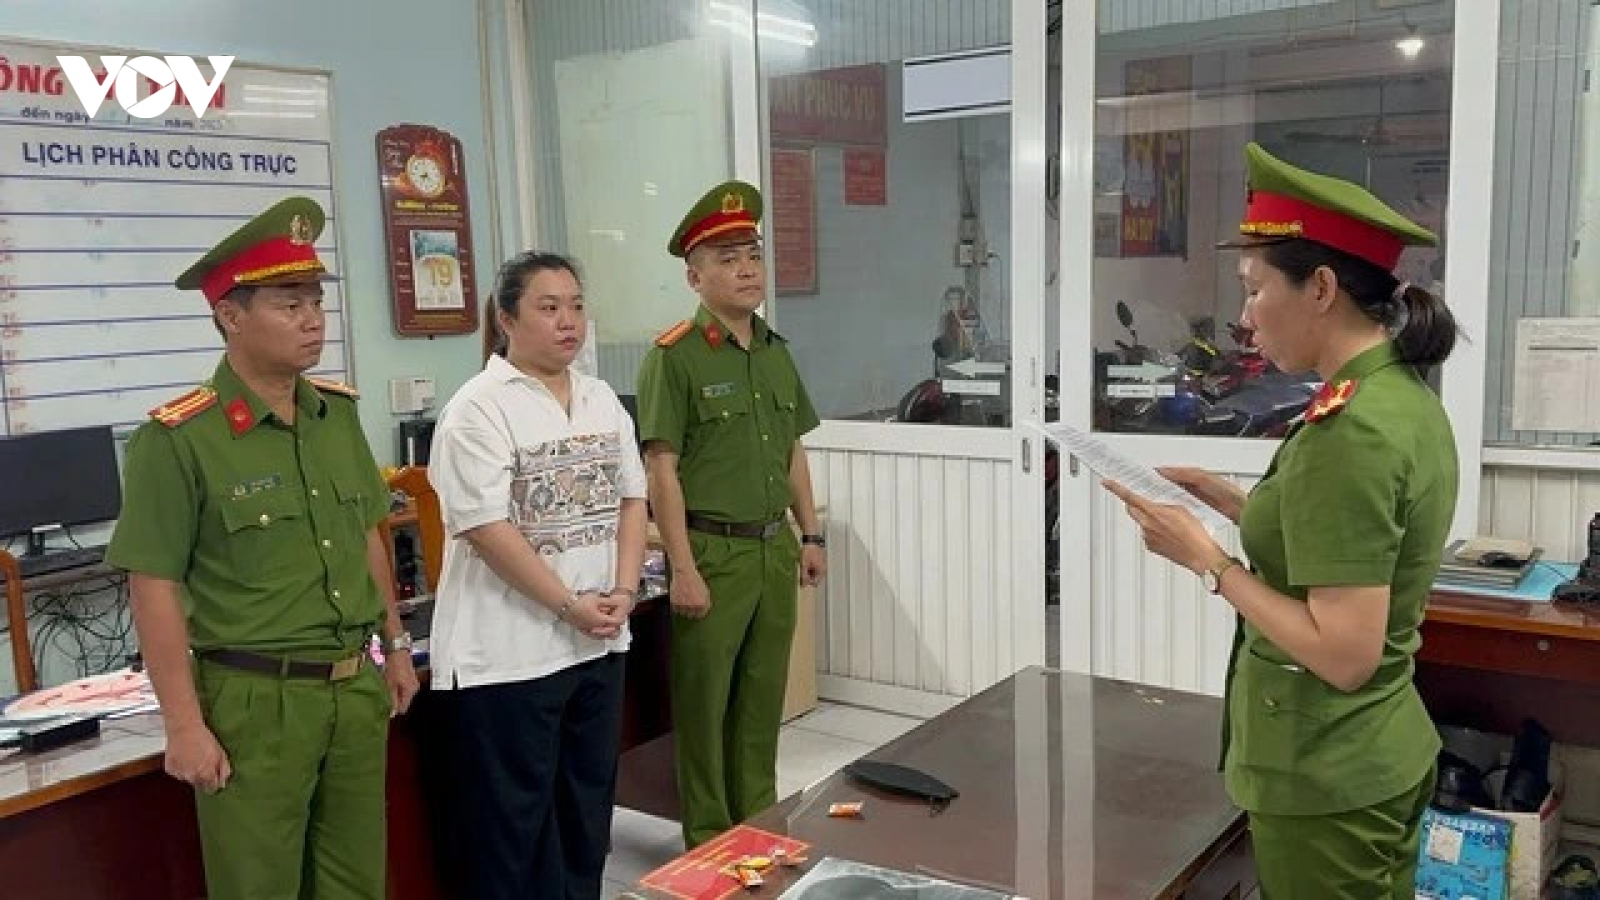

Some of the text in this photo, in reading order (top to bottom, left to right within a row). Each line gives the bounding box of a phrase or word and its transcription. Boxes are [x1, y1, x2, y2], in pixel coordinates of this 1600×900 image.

[22, 142, 297, 177] LỊCH PHÂN CÔNG TRỰC
